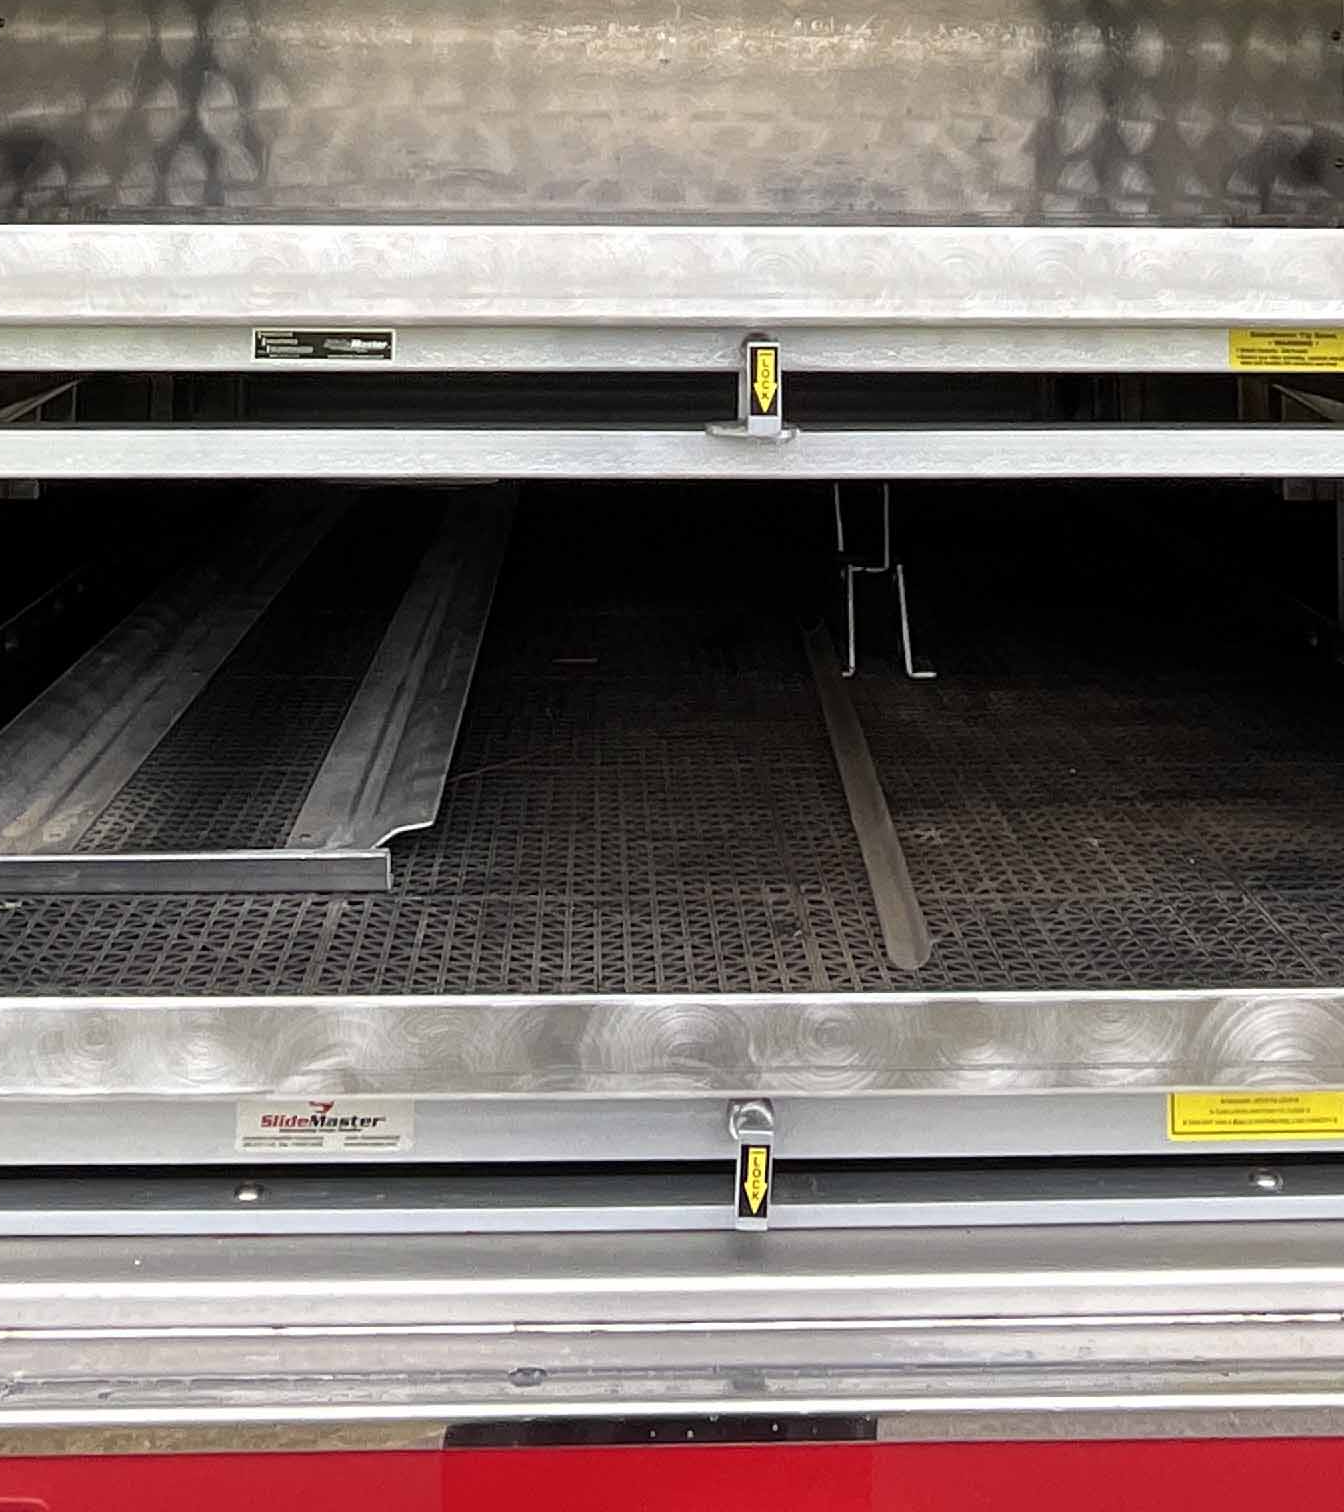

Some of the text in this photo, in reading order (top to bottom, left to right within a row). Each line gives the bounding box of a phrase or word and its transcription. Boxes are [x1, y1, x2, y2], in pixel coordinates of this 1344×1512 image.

[761, 358, 770, 400] LOCK
[260, 1114, 381, 1129] SlideMaster
[752, 1156, 762, 1200] LOCK
